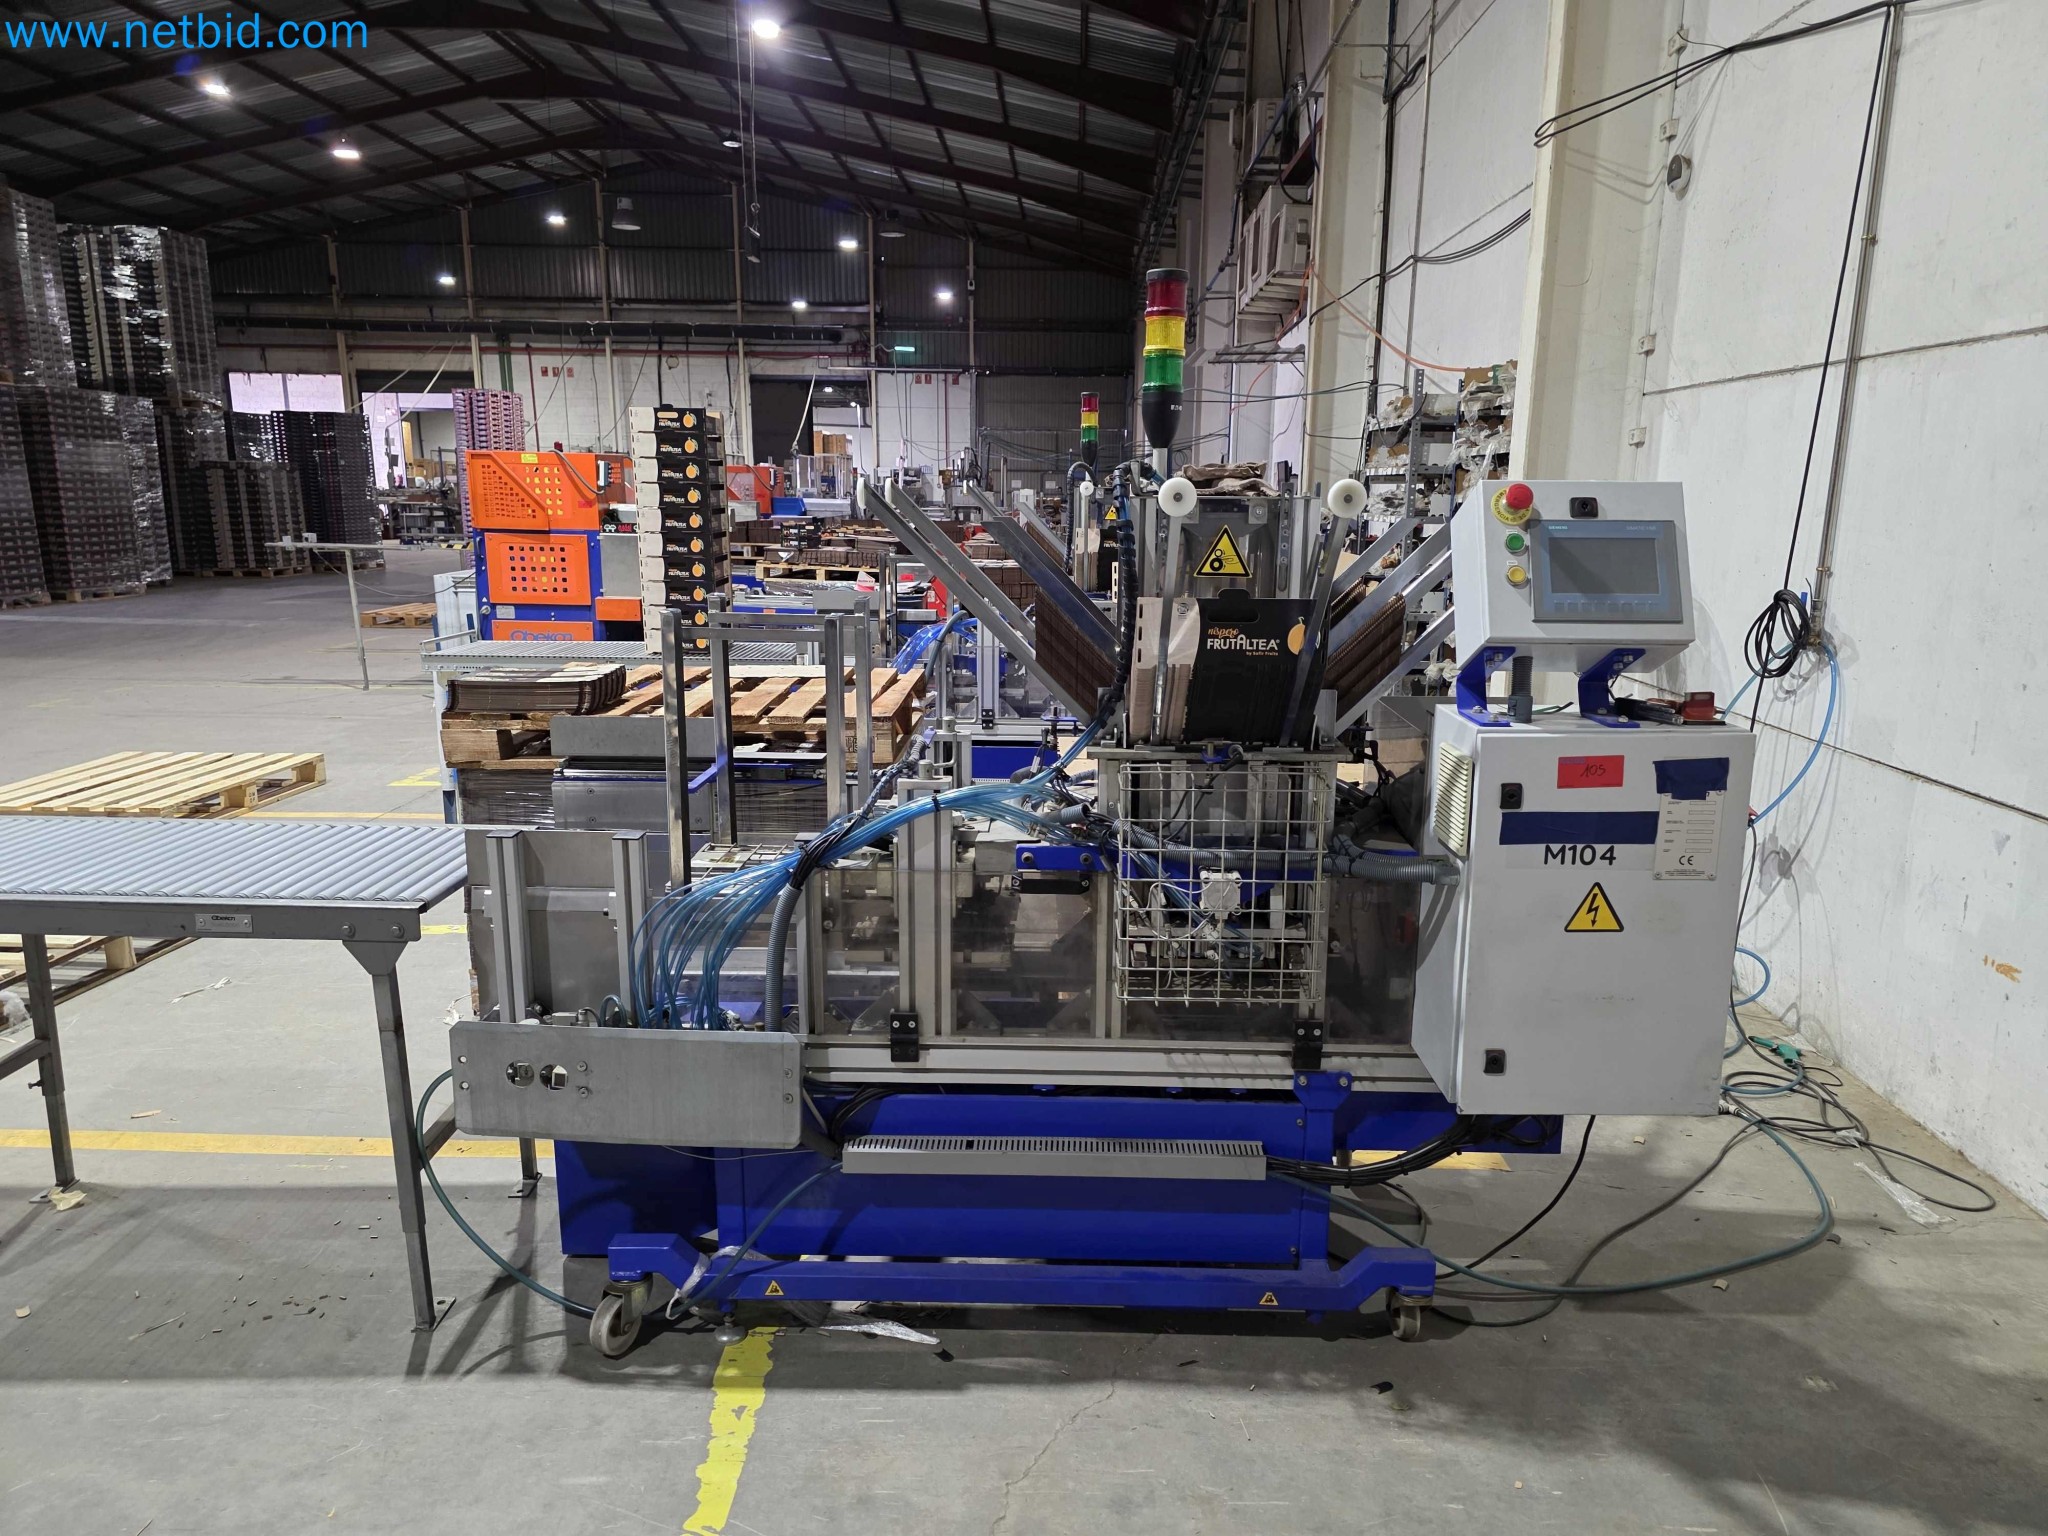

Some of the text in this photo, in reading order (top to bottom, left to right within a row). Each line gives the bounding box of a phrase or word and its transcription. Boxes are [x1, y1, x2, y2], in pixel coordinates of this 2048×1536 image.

[1207, 627, 1239, 638] nispero
[1580, 764, 1606, 777] 105
[1544, 844, 1616, 866] M104
